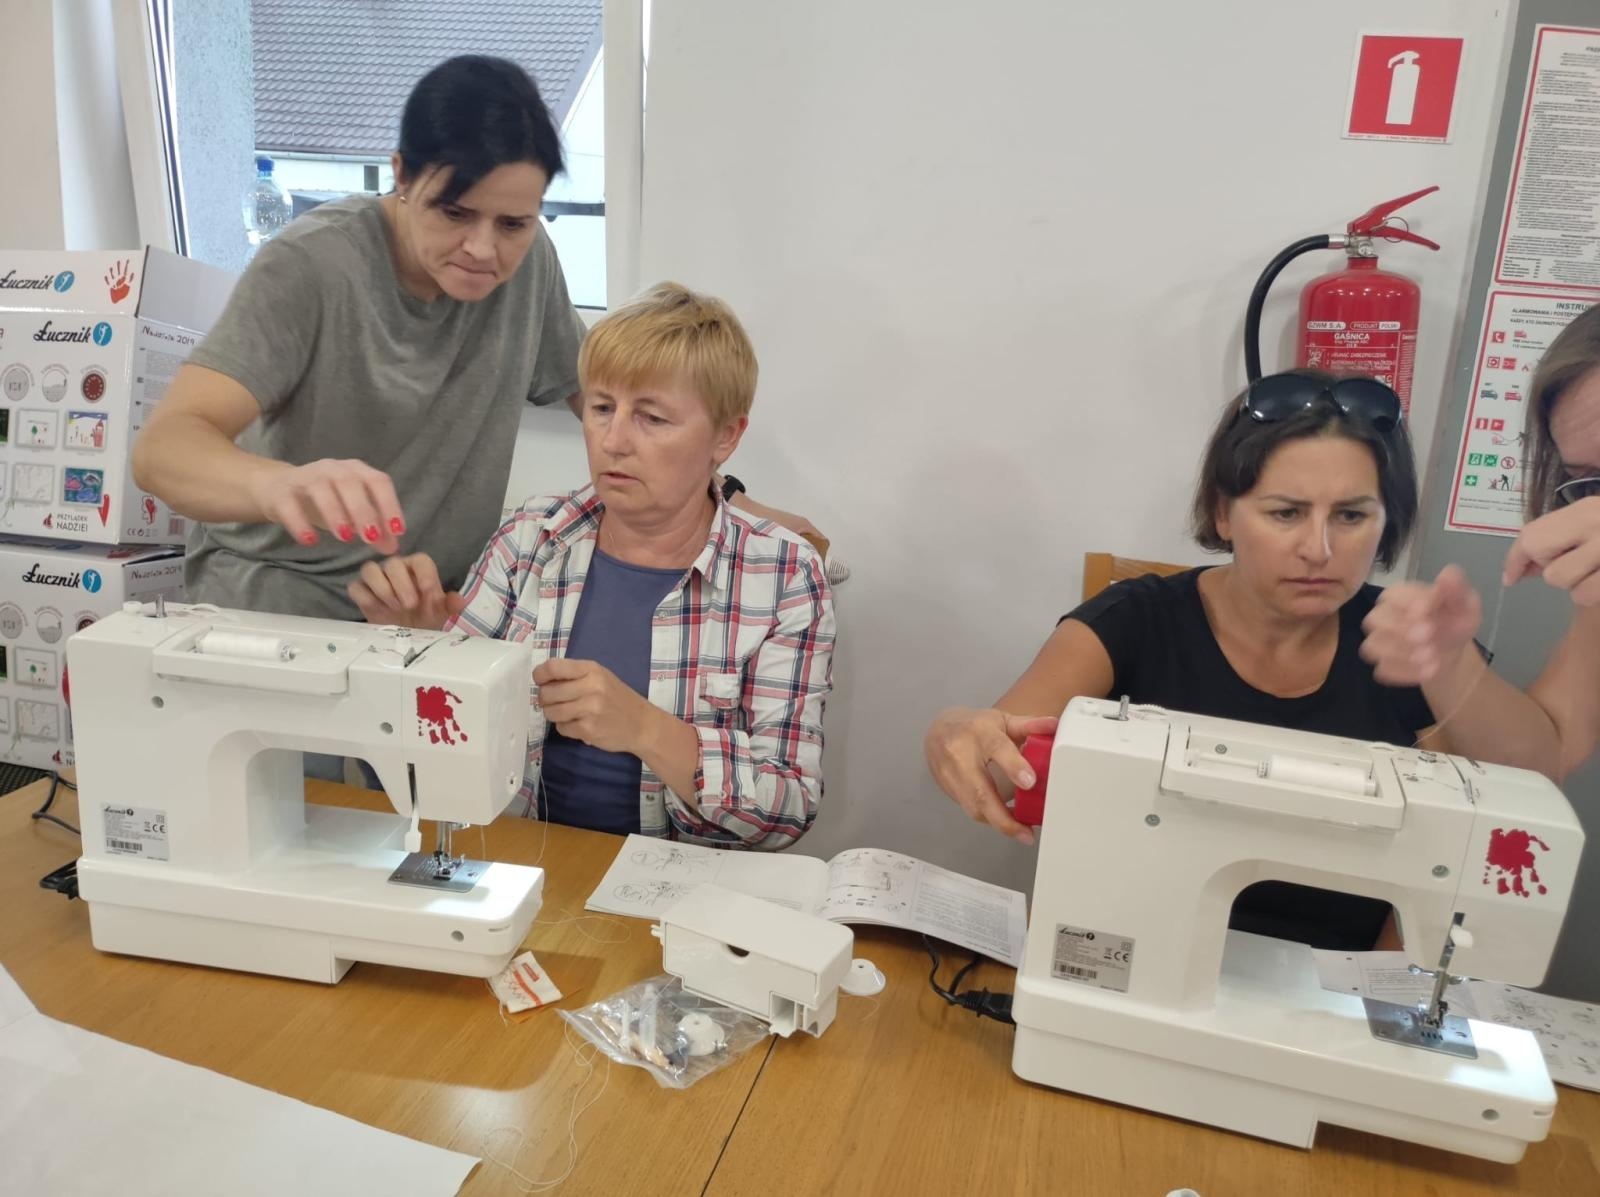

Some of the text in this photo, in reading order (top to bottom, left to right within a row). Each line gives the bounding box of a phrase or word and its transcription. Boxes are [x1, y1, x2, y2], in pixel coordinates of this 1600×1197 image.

[33, 320, 91, 343] Łucznik
[1334, 331, 1370, 340] GAŚNICA
[56, 521, 88, 532] NADZIEI
[22, 563, 81, 588] Łucznik
